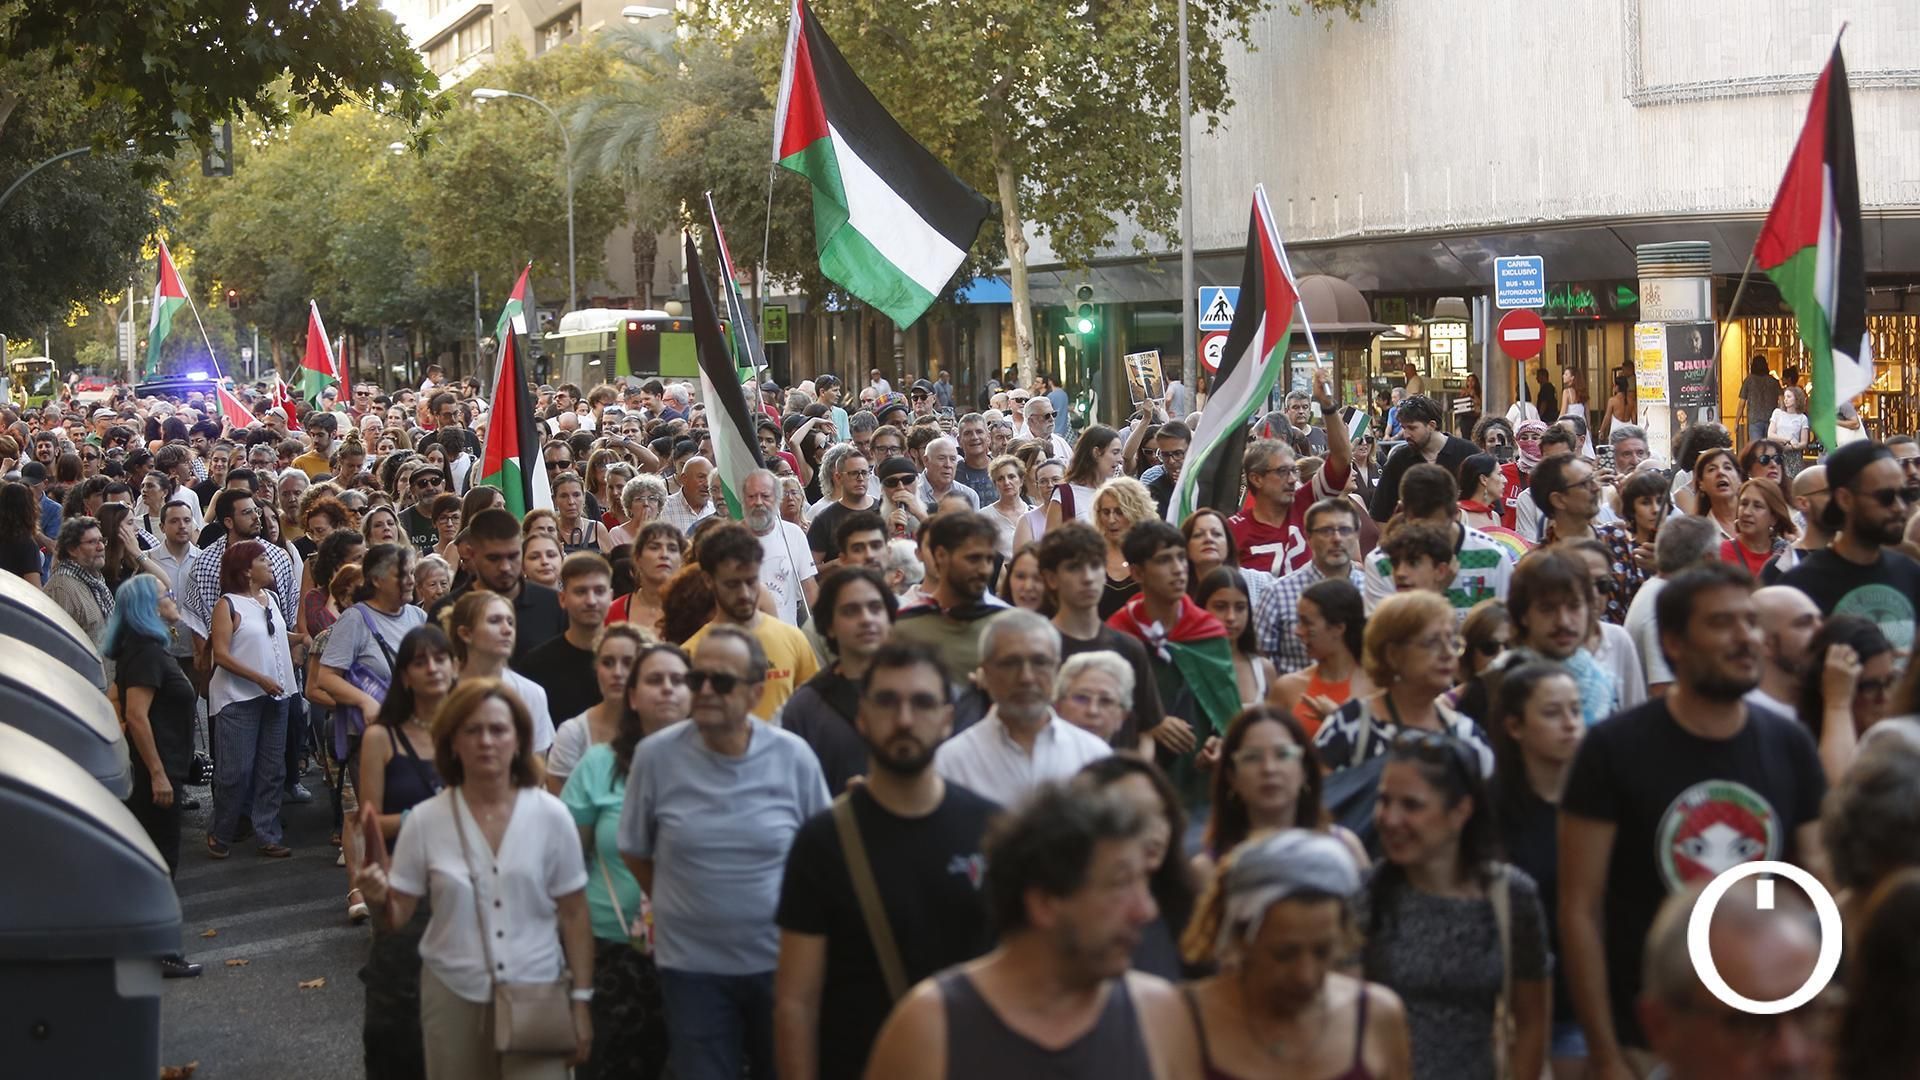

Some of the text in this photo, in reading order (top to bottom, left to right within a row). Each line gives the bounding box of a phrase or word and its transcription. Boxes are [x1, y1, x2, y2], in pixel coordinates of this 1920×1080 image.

[1507, 260, 1531, 268] CARRIL
[1501, 268, 1538, 277] EXCLUSIVO
[1499, 297, 1543, 305] MOTOCICLETAS
[640, 323, 656, 332] 104
[412, 533, 439, 544] NO A
[1250, 525, 1307, 578] 72
[767, 669, 790, 680] FILM
